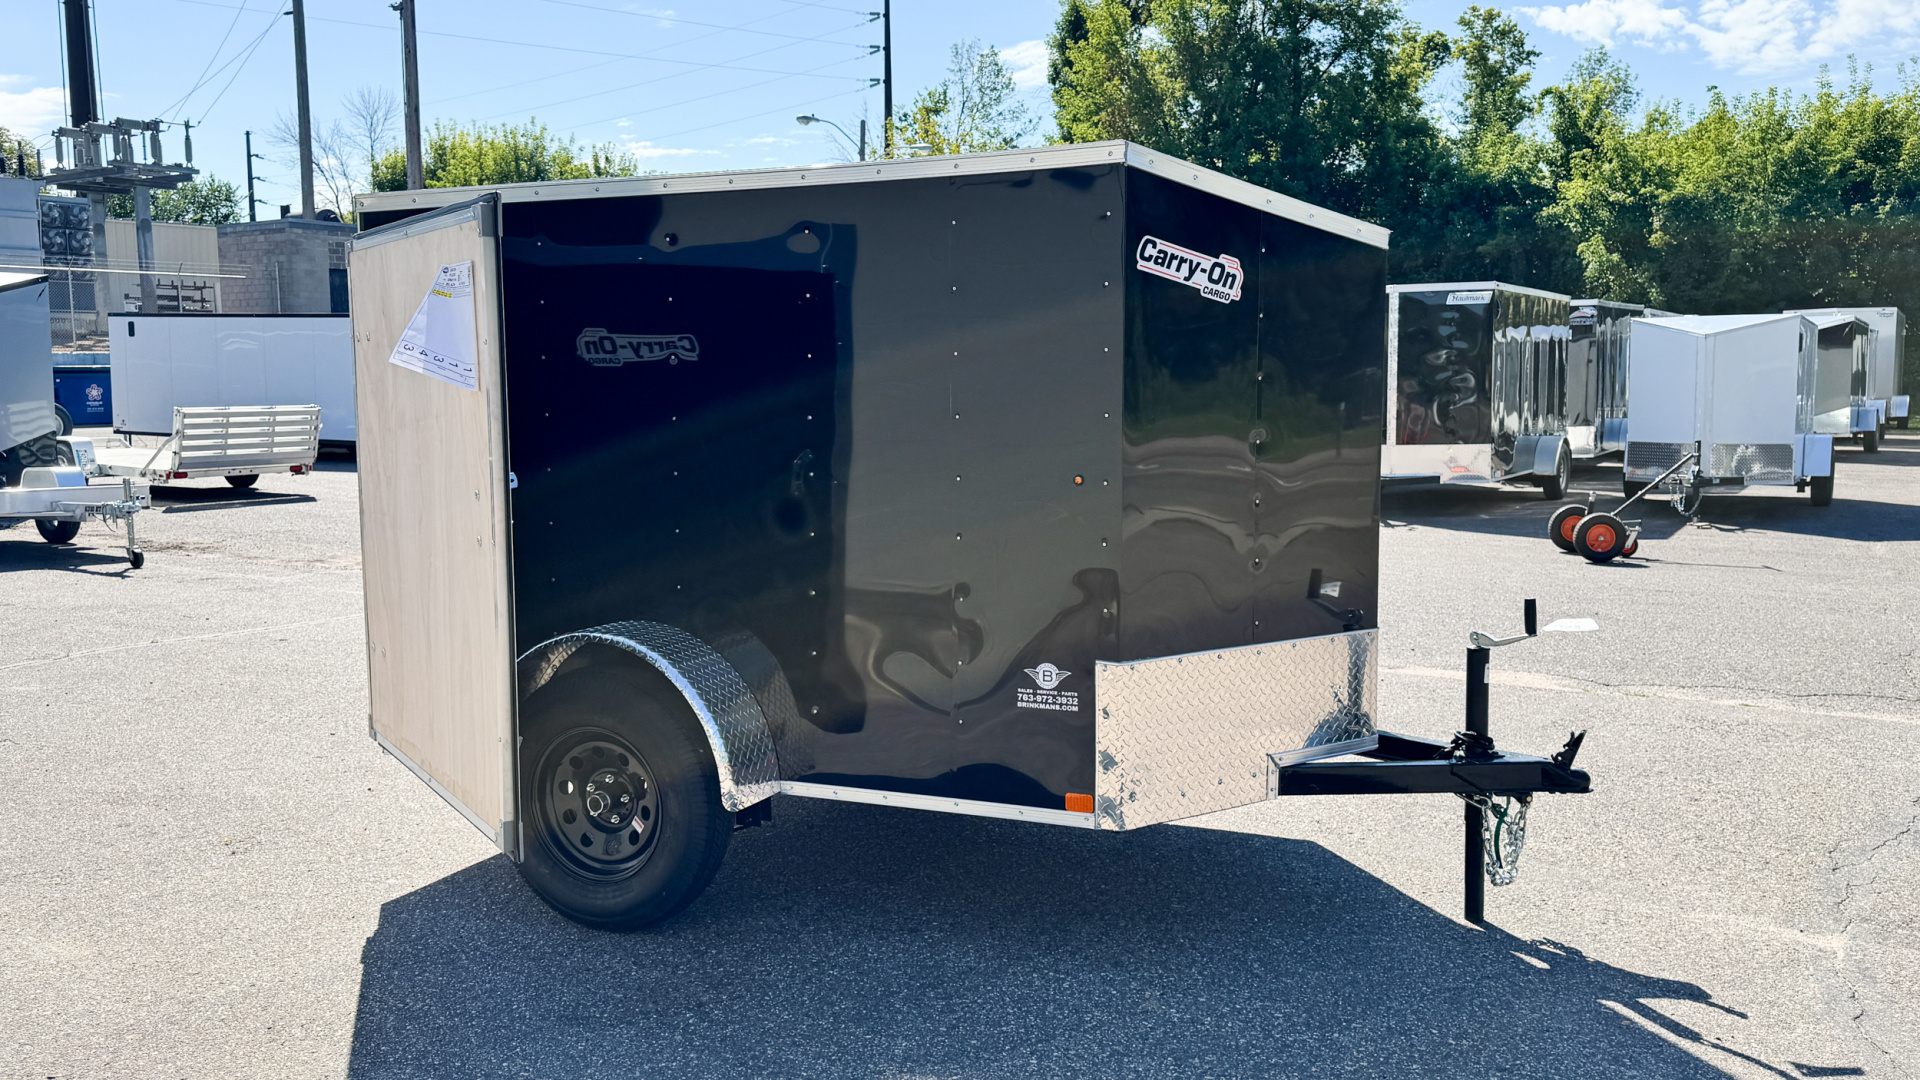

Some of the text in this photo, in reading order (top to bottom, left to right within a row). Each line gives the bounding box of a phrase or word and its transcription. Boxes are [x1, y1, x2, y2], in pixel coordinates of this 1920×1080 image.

[1138, 238, 1237, 290] Carry-On
[1202, 286, 1231, 301] CARGO
[1042, 669, 1053, 682] B
[1017, 693, 1079, 705] 763-972-3932
[1017, 701, 1079, 712] BRINKMANS.COM
